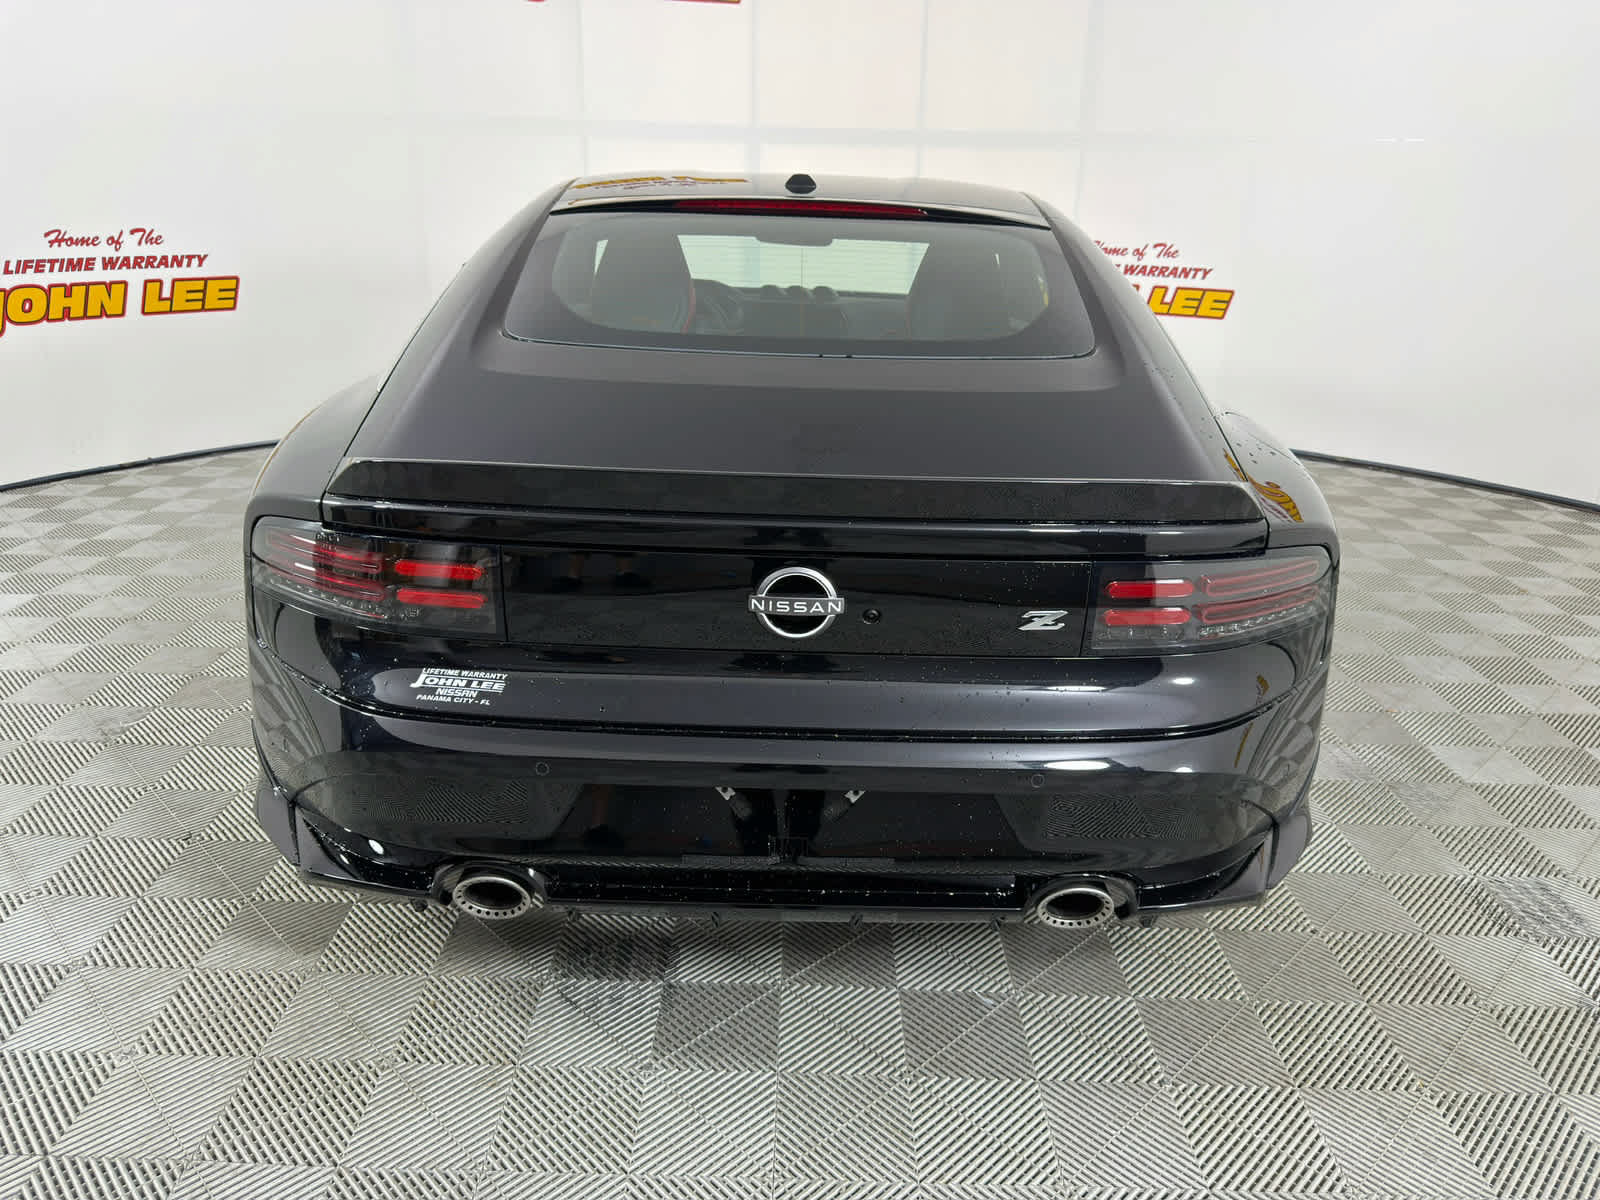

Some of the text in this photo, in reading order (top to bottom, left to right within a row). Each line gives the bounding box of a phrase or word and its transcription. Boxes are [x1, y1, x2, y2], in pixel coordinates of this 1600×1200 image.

[44, 228, 164, 251] Home of The
[1132, 244, 1149, 261] of
[1153, 243, 1180, 259] The
[3, 254, 208, 275] LIFETIME WARRANTY
[1123, 264, 1213, 280] WARRANTY
[141, 276, 240, 316] LEE
[1147, 285, 1235, 320] LEE
[751, 598, 843, 613] NISSAN
[1018, 610, 1069, 631] Z
[409, 674, 506, 691] JOHN LEE
[422, 668, 508, 680] LIFETIME WARRANTY
[436, 688, 478, 697] NISSAN
